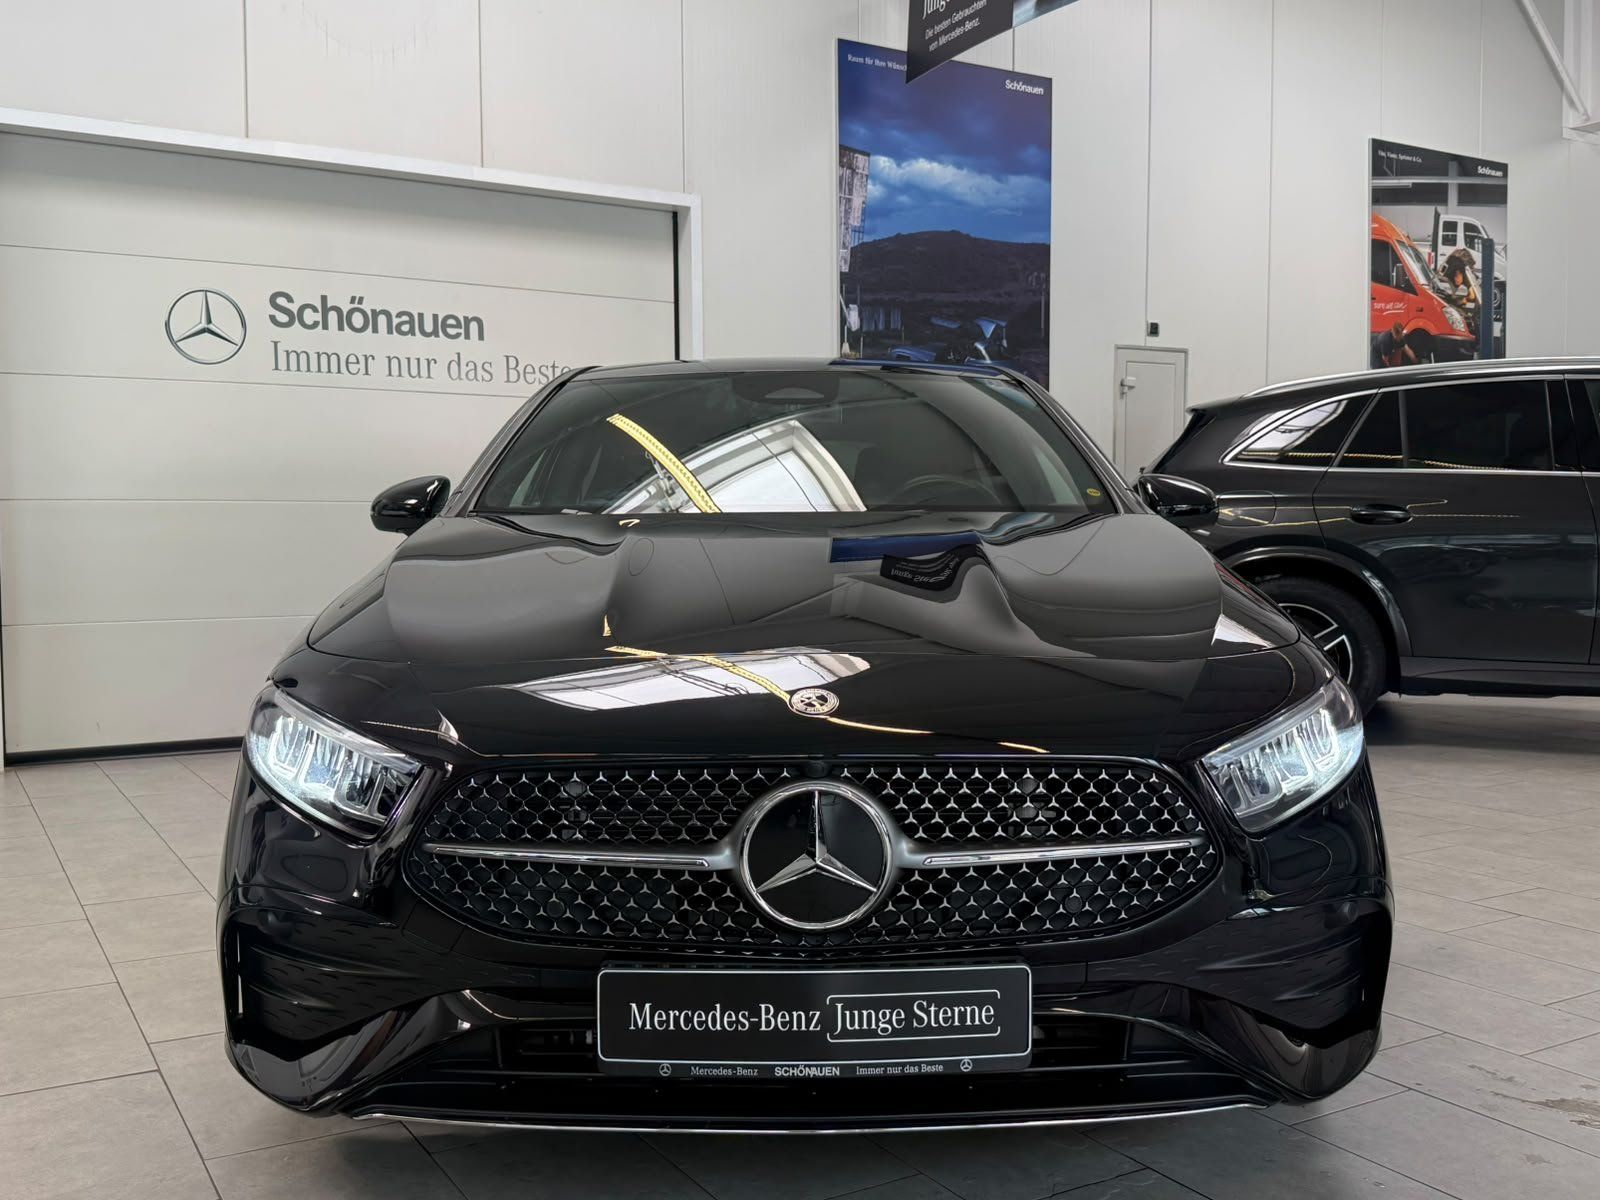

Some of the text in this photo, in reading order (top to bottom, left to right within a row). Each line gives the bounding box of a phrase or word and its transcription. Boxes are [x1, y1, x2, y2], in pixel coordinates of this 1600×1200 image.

[925, 0, 988, 40] Die besten Gebrauchten
[929, 18, 981, 52] von Mercedes-Benz.
[847, 53, 864, 63] Raum
[865, 56, 874, 65] für
[874, 59, 886, 67] Ihre
[1005, 79, 1044, 96] Schönauen
[268, 291, 485, 341] Schönauen
[270, 340, 375, 377] Immer
[385, 355, 438, 380] nur
[447, 352, 494, 383] das
[628, 1000, 995, 1036] Mercedes-Benz Junge Sterne
[690, 1062, 944, 1079] Mercedes-Benz SCHÖNAUEN Immer nur das Beste
